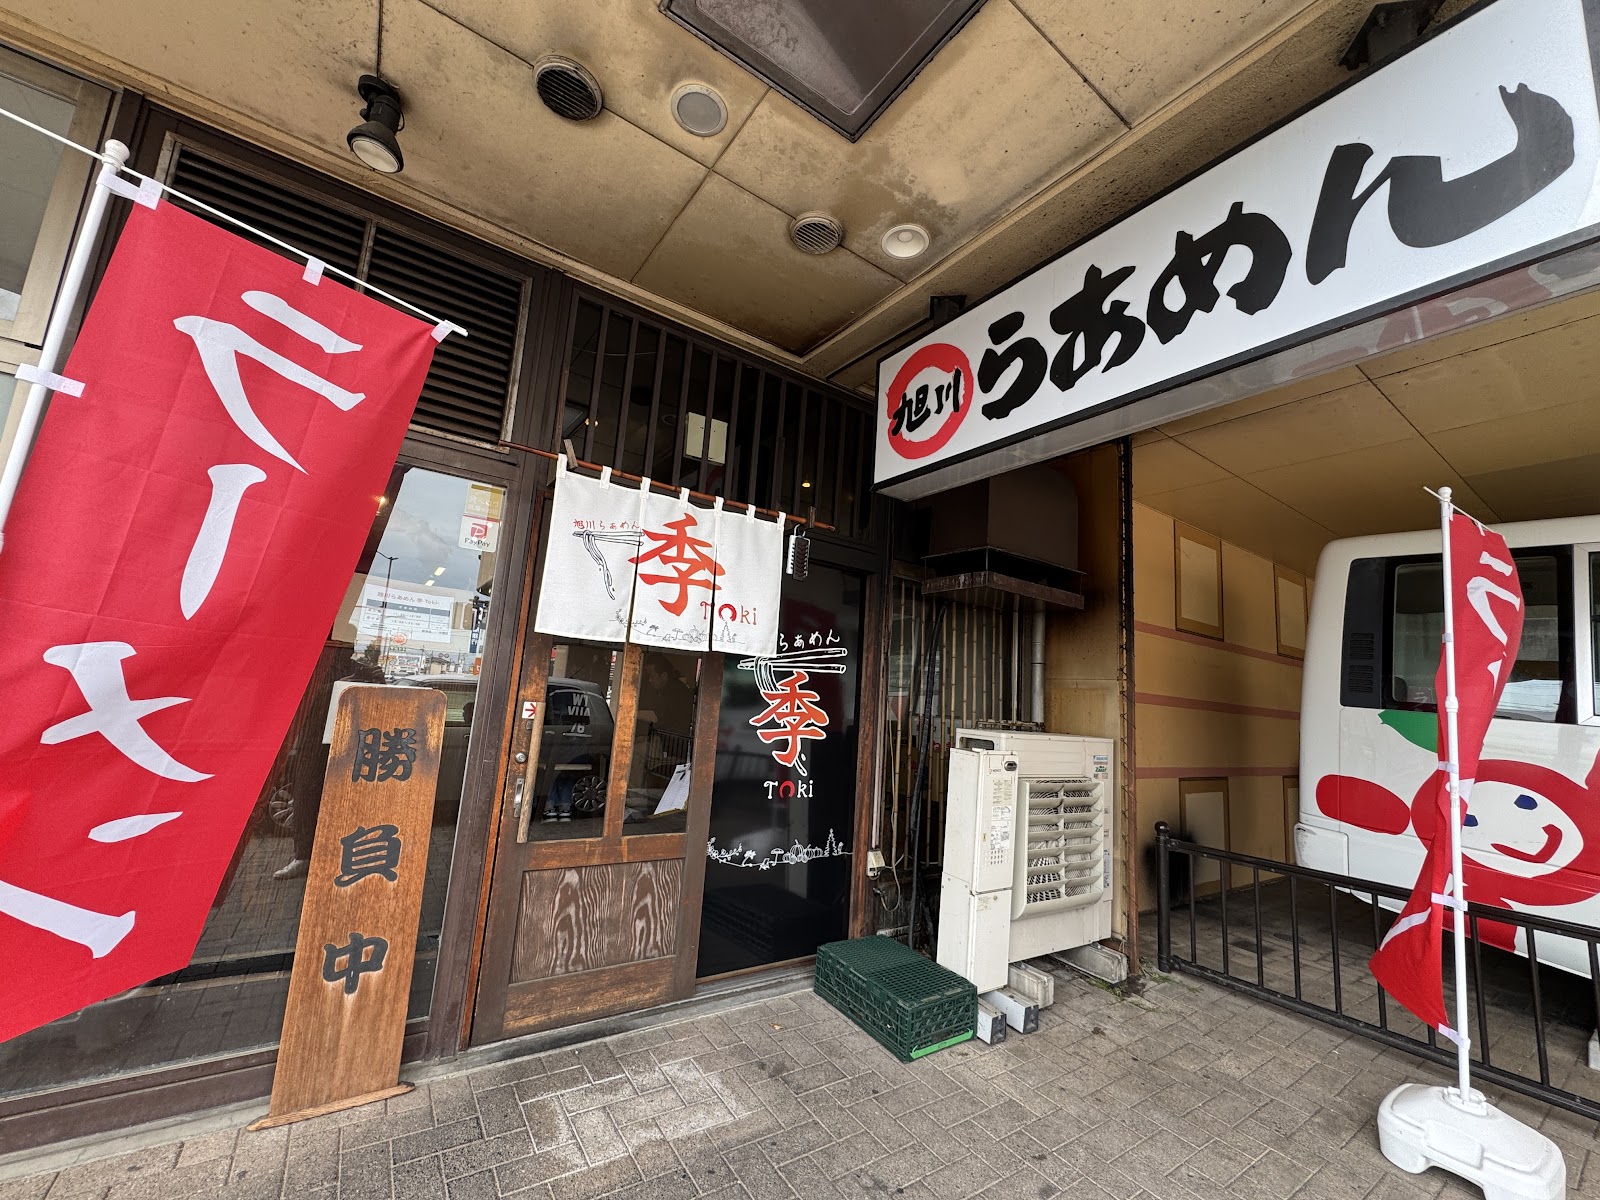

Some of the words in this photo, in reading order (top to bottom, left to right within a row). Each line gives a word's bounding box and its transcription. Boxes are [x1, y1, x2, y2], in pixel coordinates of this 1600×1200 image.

[890, 364, 963, 438] 旭川
[976, 81, 1576, 421] らあめん
[464, 537, 491, 548] PayPay
[572, 517, 642, 531] 旭川らあめん
[628, 512, 726, 617] 季
[749, 669, 829, 767] 季
[322, 726, 418, 996] 勝負中
